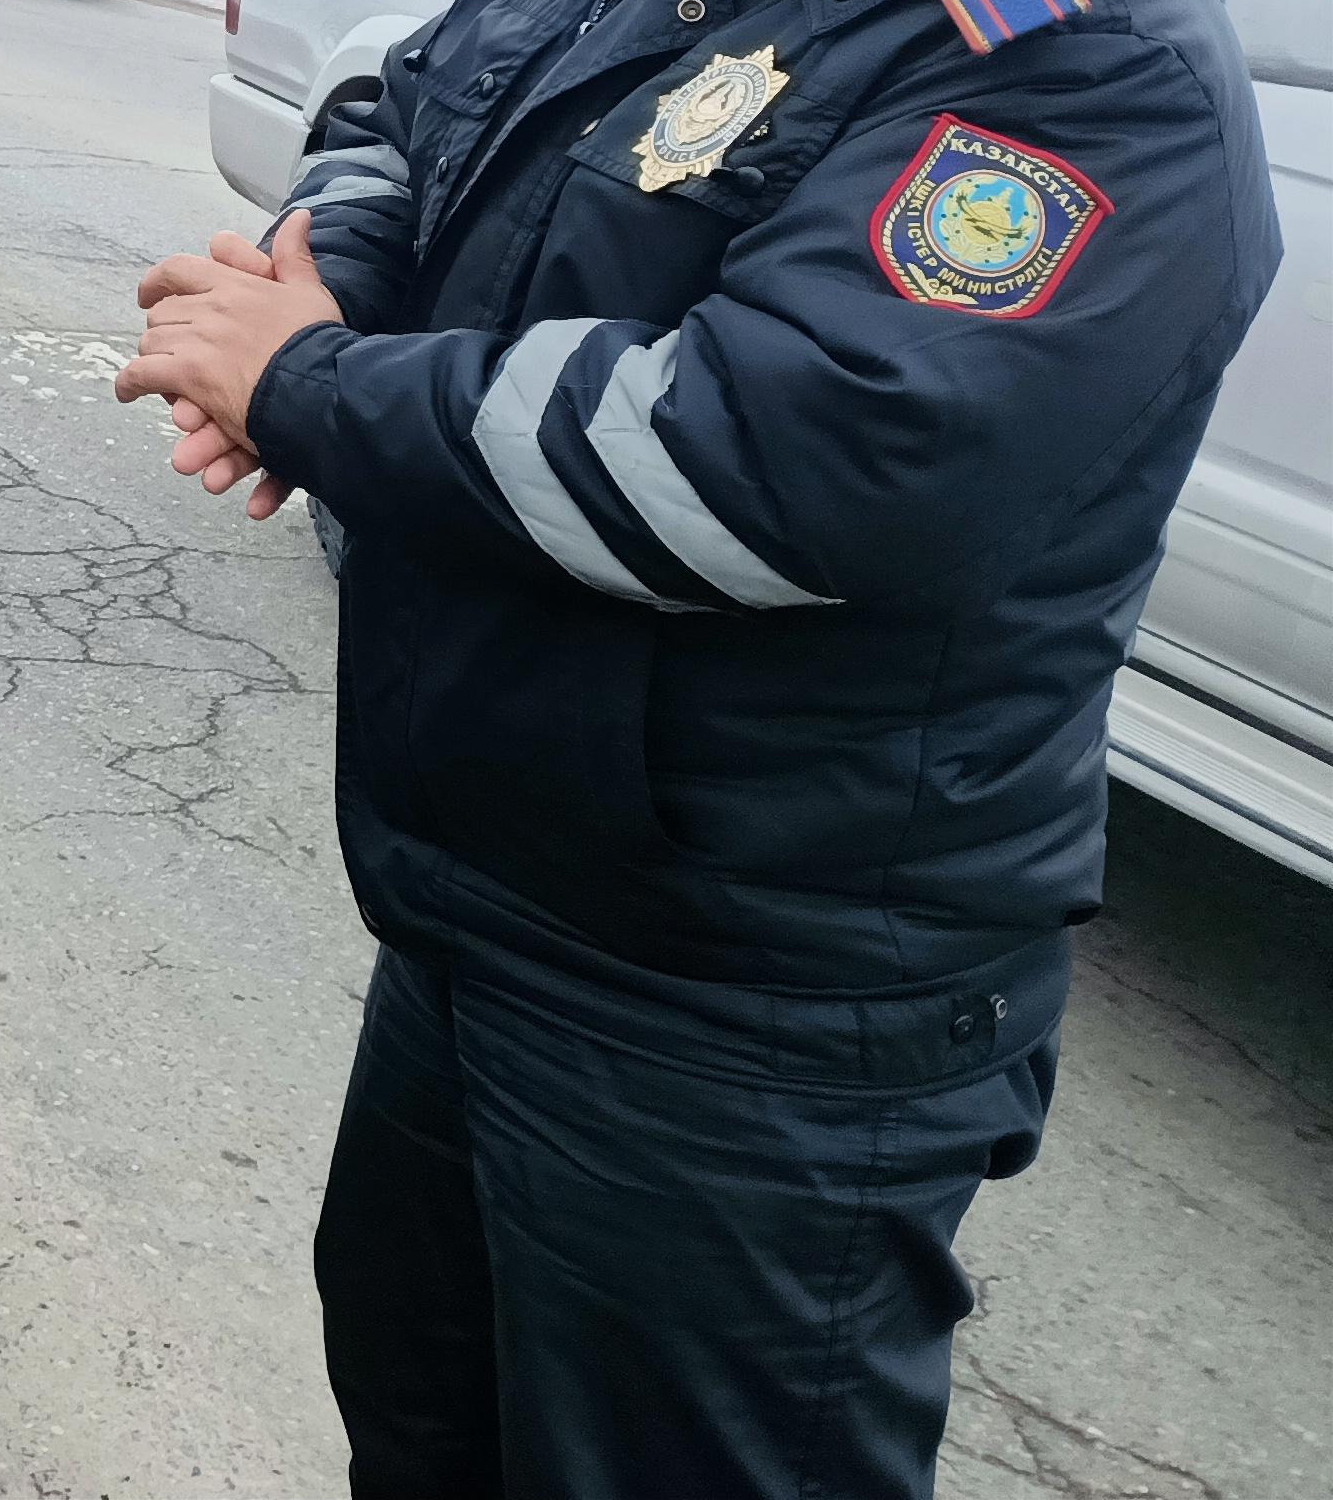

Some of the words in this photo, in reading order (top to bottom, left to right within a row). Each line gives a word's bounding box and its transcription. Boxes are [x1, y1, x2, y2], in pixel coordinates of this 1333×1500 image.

[654, 139, 698, 161] POLICE
[907, 222, 938, 267] ІСТЕР
[937, 247, 1053, 295] МИНИСТРЛІГІ
